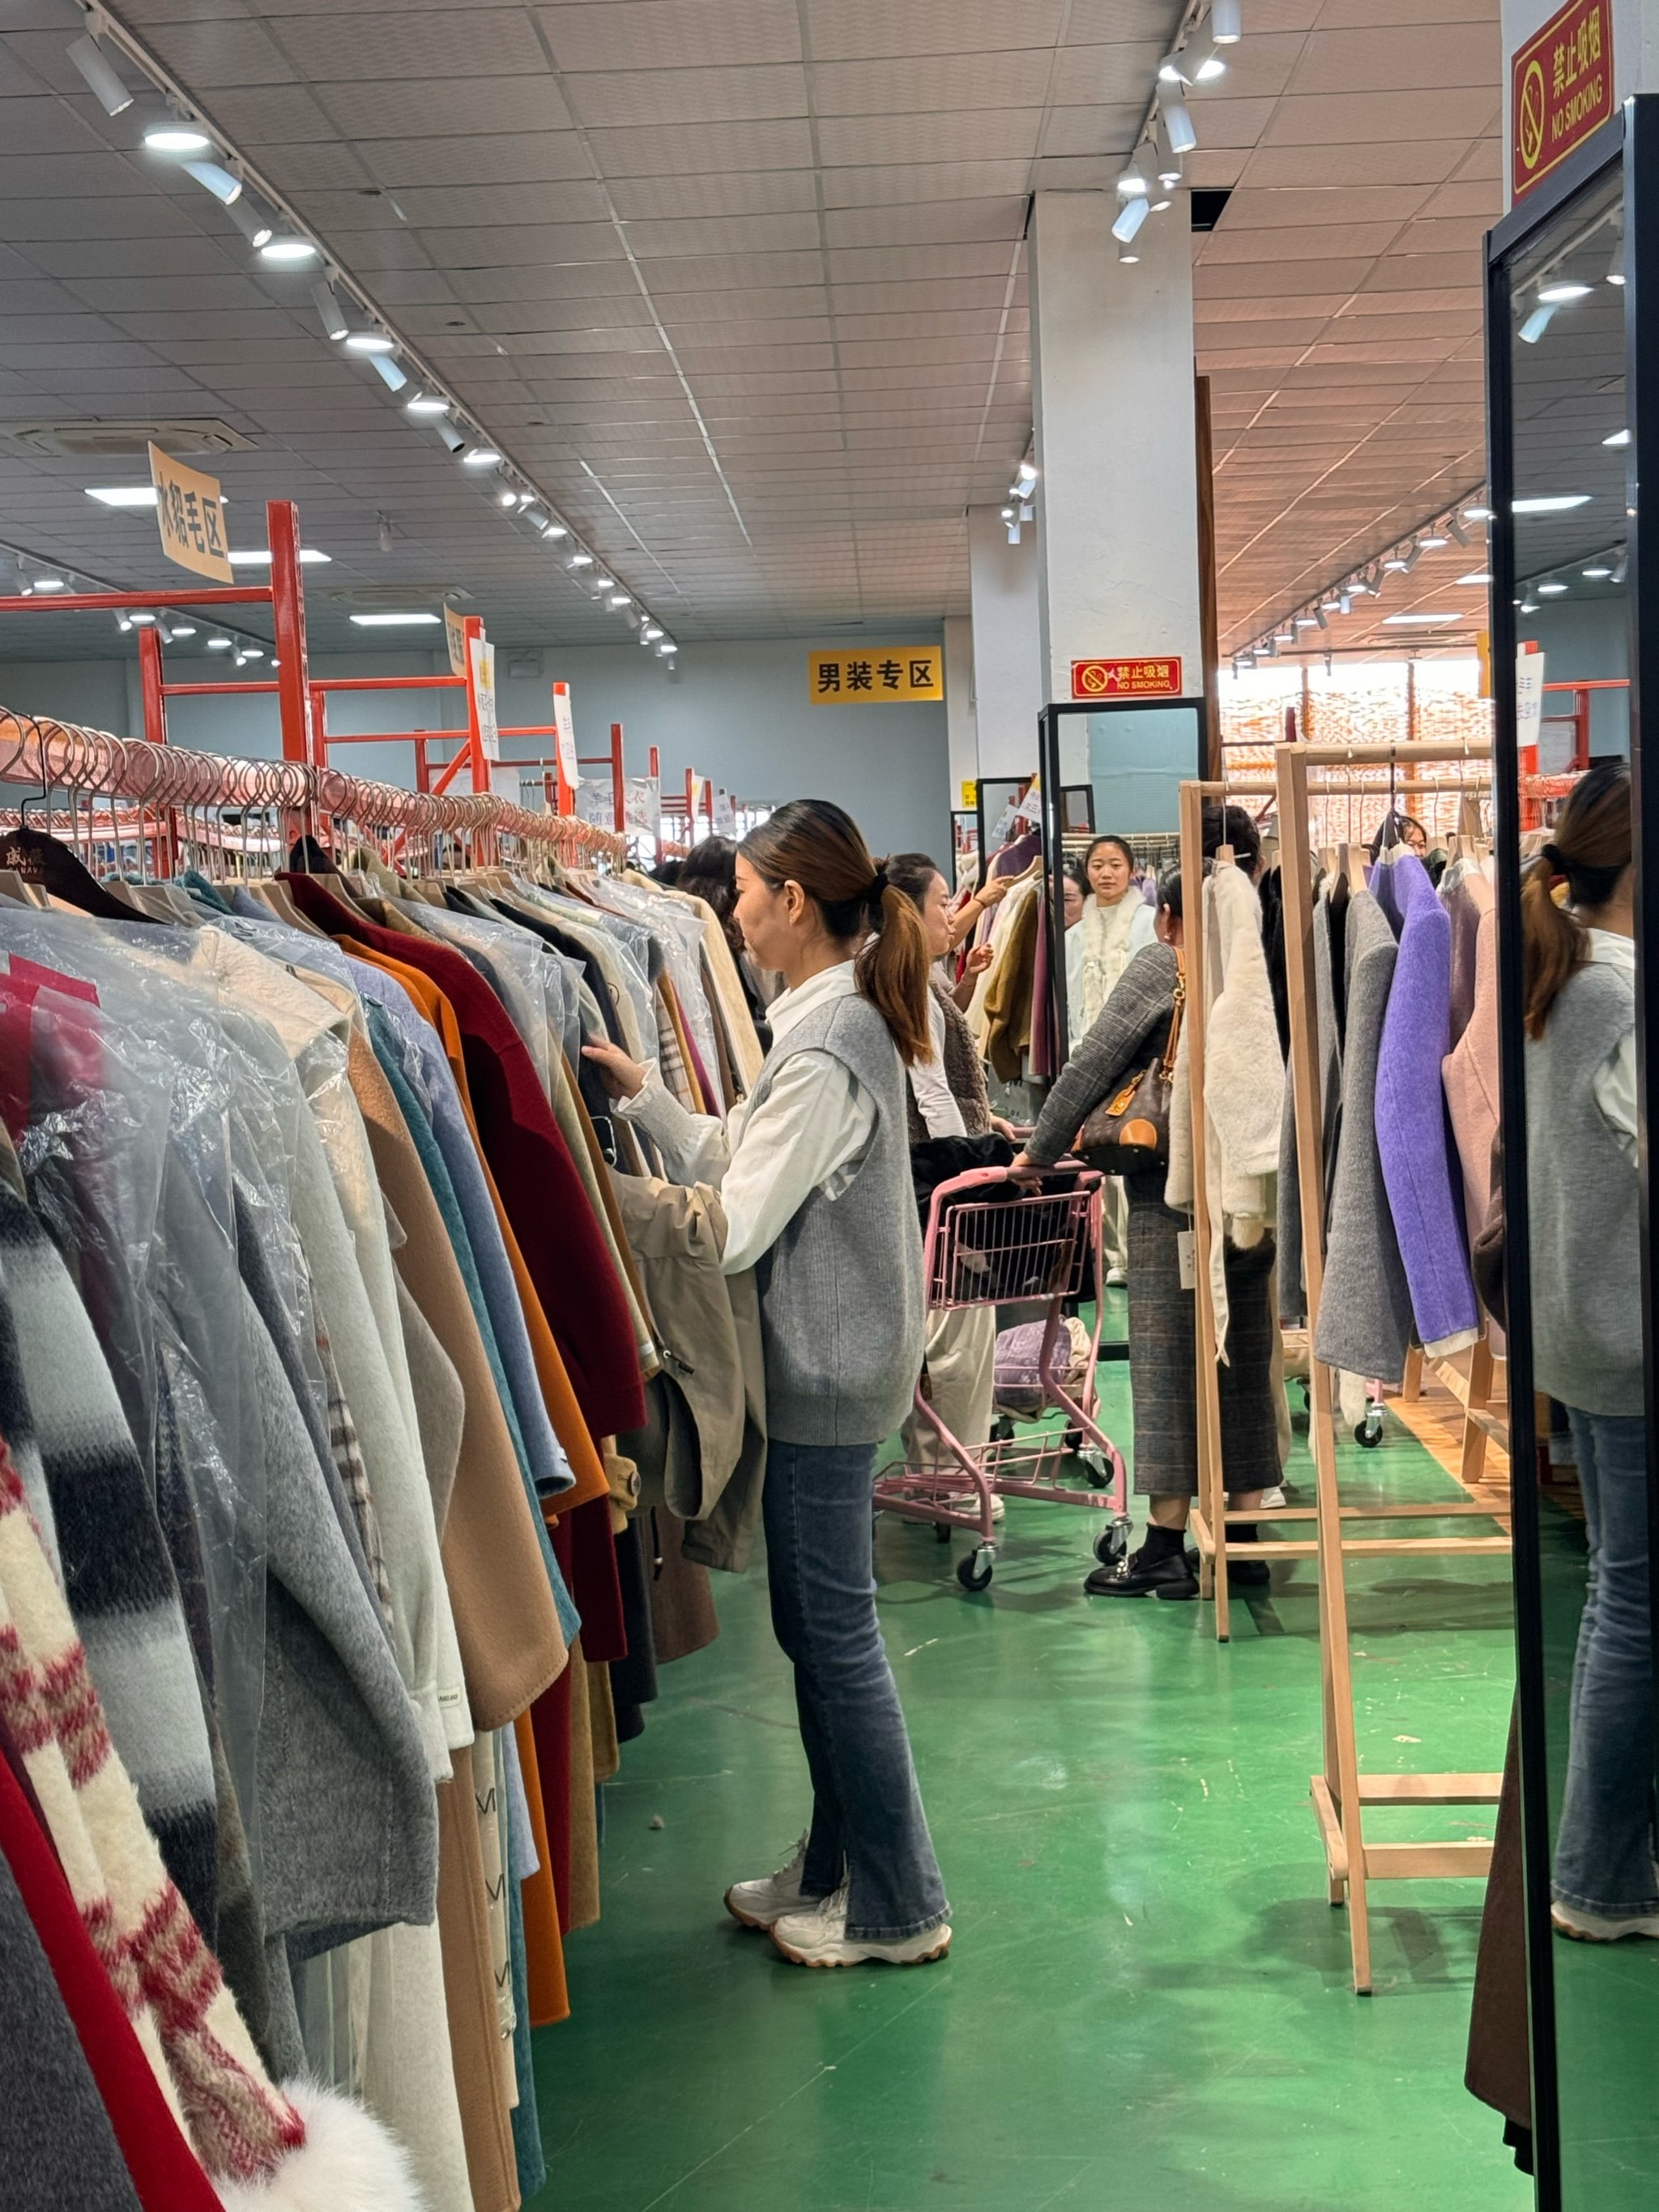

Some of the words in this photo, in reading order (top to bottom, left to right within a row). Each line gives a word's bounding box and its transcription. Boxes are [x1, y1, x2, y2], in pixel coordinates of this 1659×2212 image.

[1553, 6, 1601, 99] 禁止吸烟
[1551, 109, 1564, 143] NO
[1565, 74, 1602, 130] SMOKING
[158, 471, 225, 558] 水貂毛区
[817, 660, 934, 694] 男装专区
[1117, 681, 1130, 690] NO
[1131, 680, 1171, 689] SMOKING
[1118, 664, 1169, 679] 禁止吸烟
